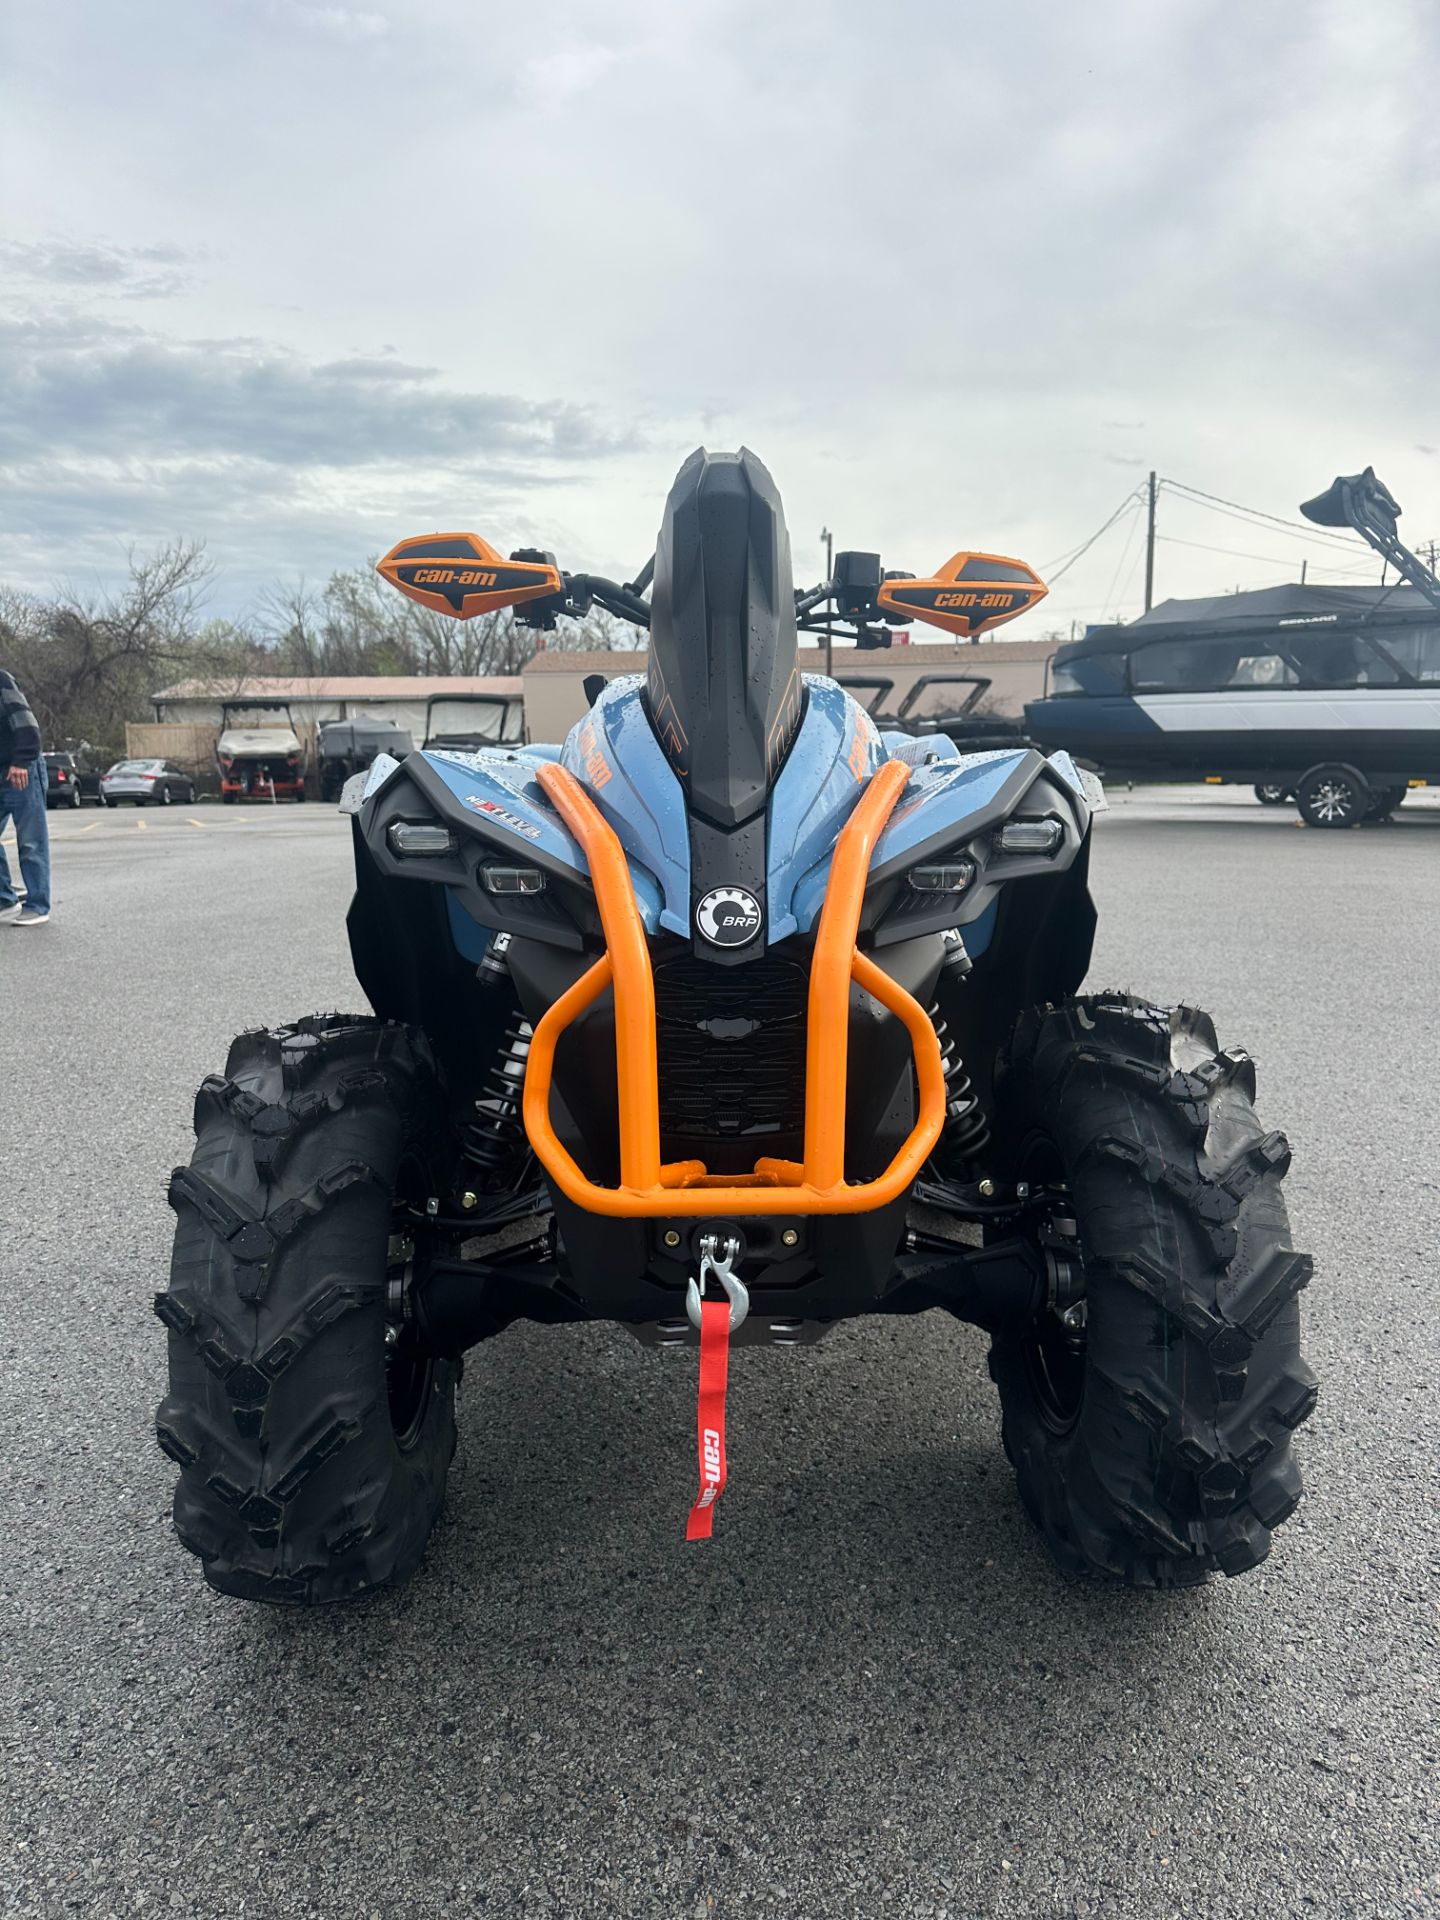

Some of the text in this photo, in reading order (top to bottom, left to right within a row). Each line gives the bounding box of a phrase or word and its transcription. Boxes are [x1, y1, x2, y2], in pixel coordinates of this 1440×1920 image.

[414, 569, 496, 586] can-am
[934, 593, 1013, 607] can-am
[722, 916, 757, 927] BRP
[697, 1428, 721, 1509] can-am
